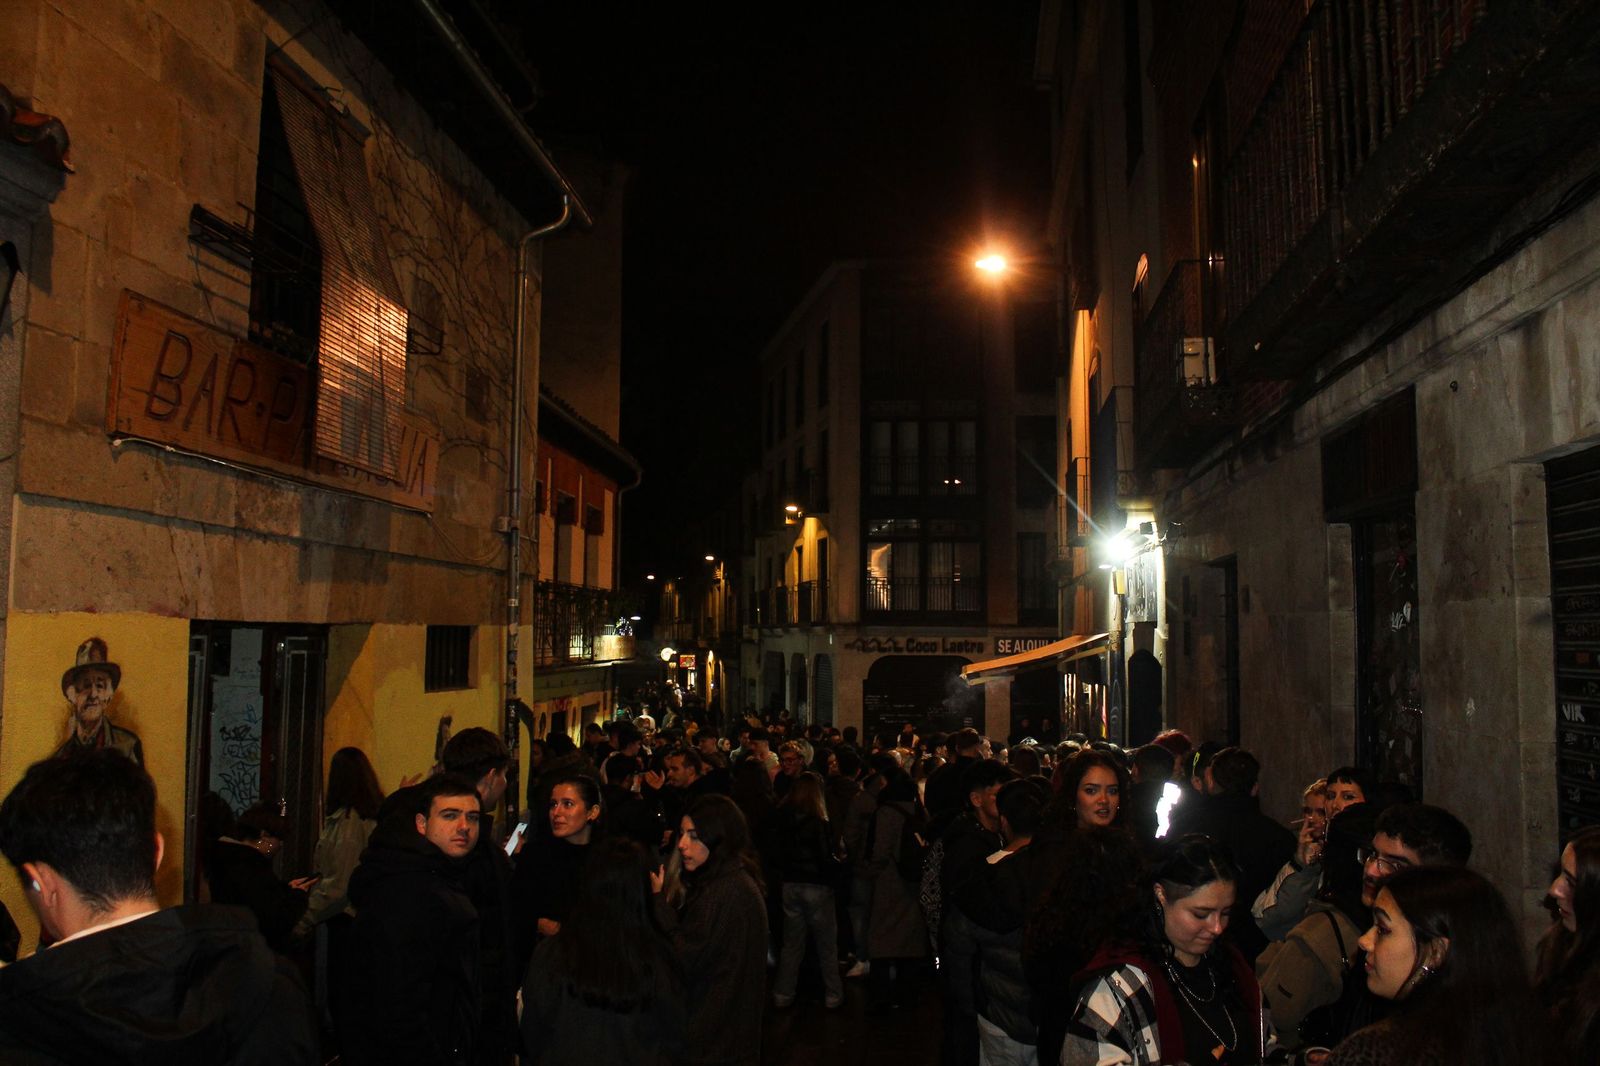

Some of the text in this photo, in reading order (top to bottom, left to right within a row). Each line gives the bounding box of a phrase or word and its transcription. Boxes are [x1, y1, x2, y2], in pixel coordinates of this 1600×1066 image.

[905, 637, 984, 653] Coco Lastra
[998, 639, 1012, 653] SE
